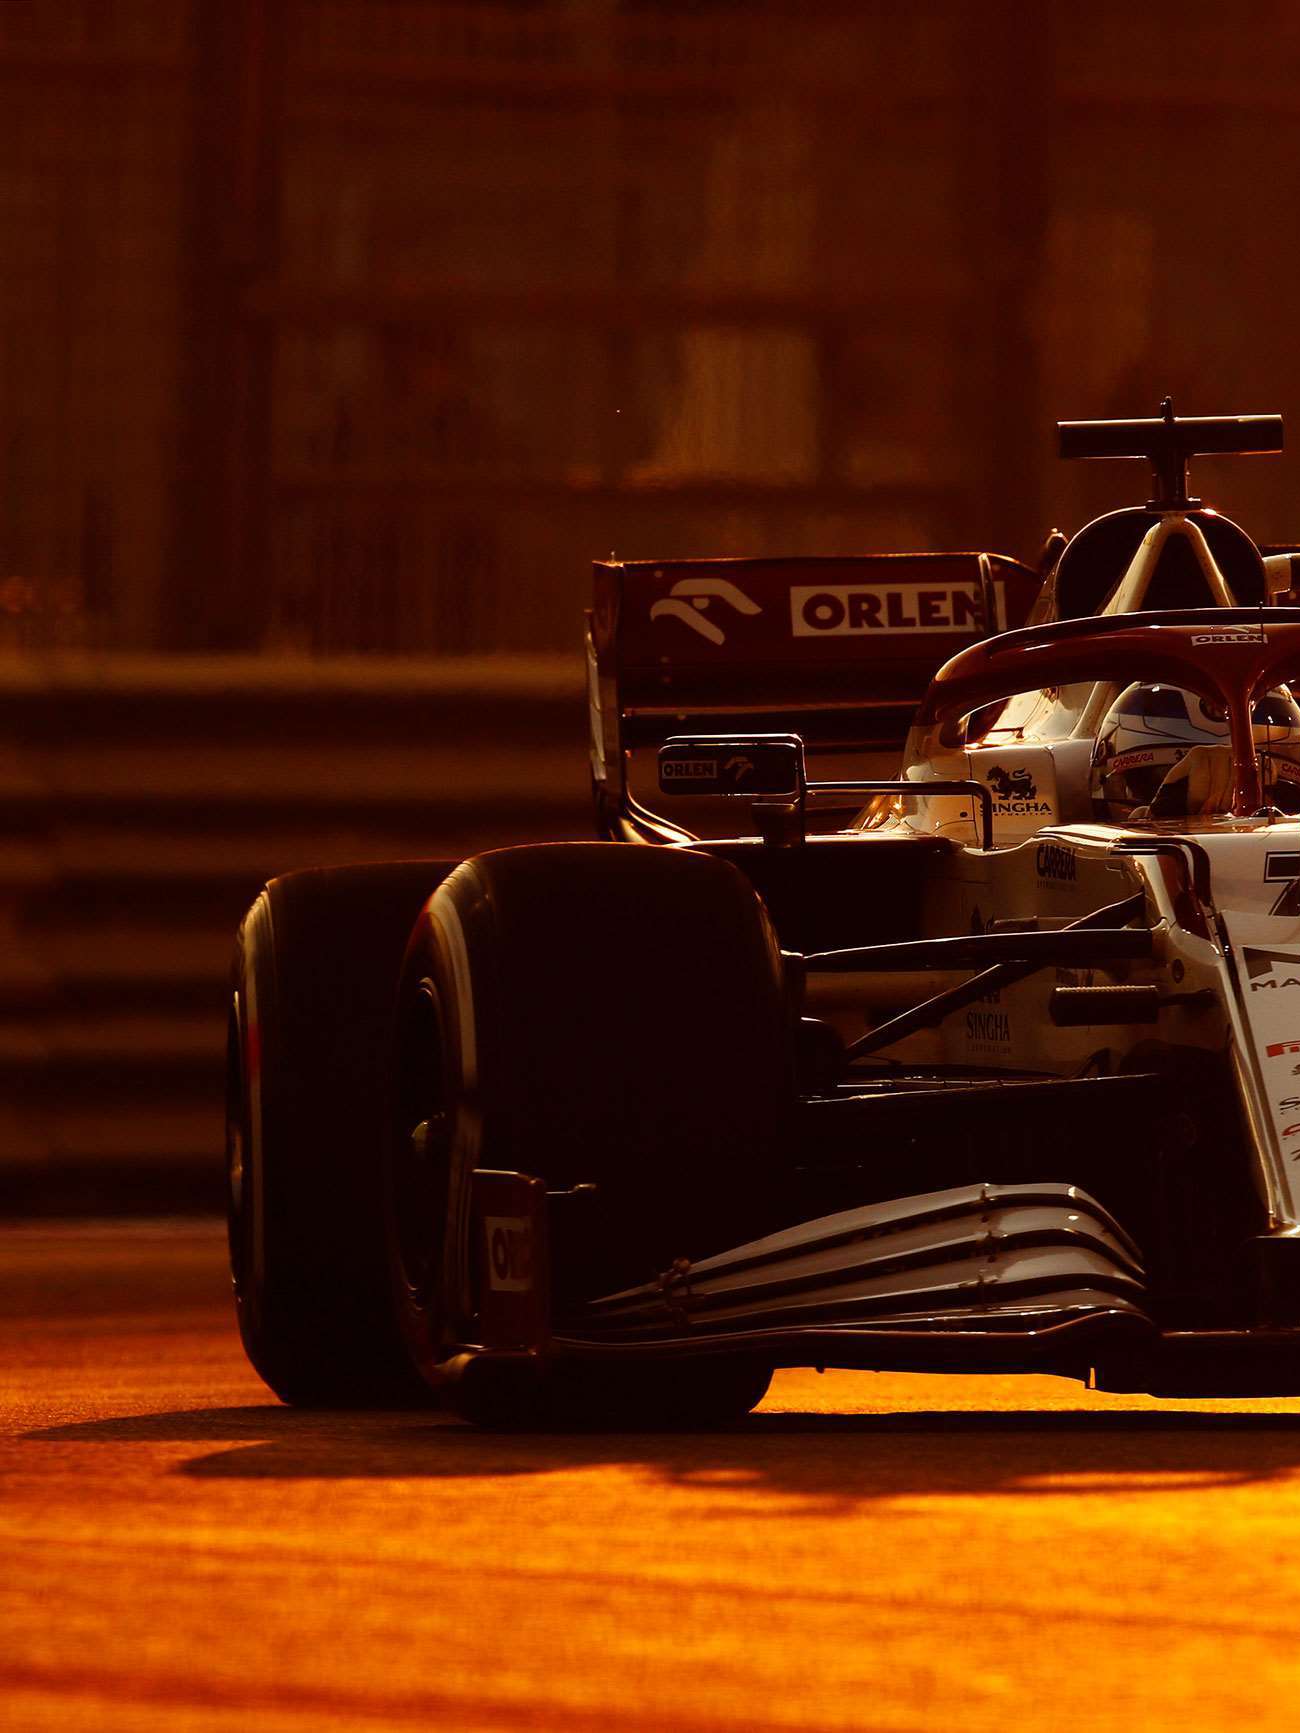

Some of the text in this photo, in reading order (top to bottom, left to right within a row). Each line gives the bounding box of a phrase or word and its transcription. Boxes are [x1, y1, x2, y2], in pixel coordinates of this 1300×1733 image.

[803, 590, 983, 629] ORLEN
[1195, 635, 1264, 643] ORLEN
[664, 762, 714, 777] ORLEN
[967, 1011, 1010, 1041] SINGHA
